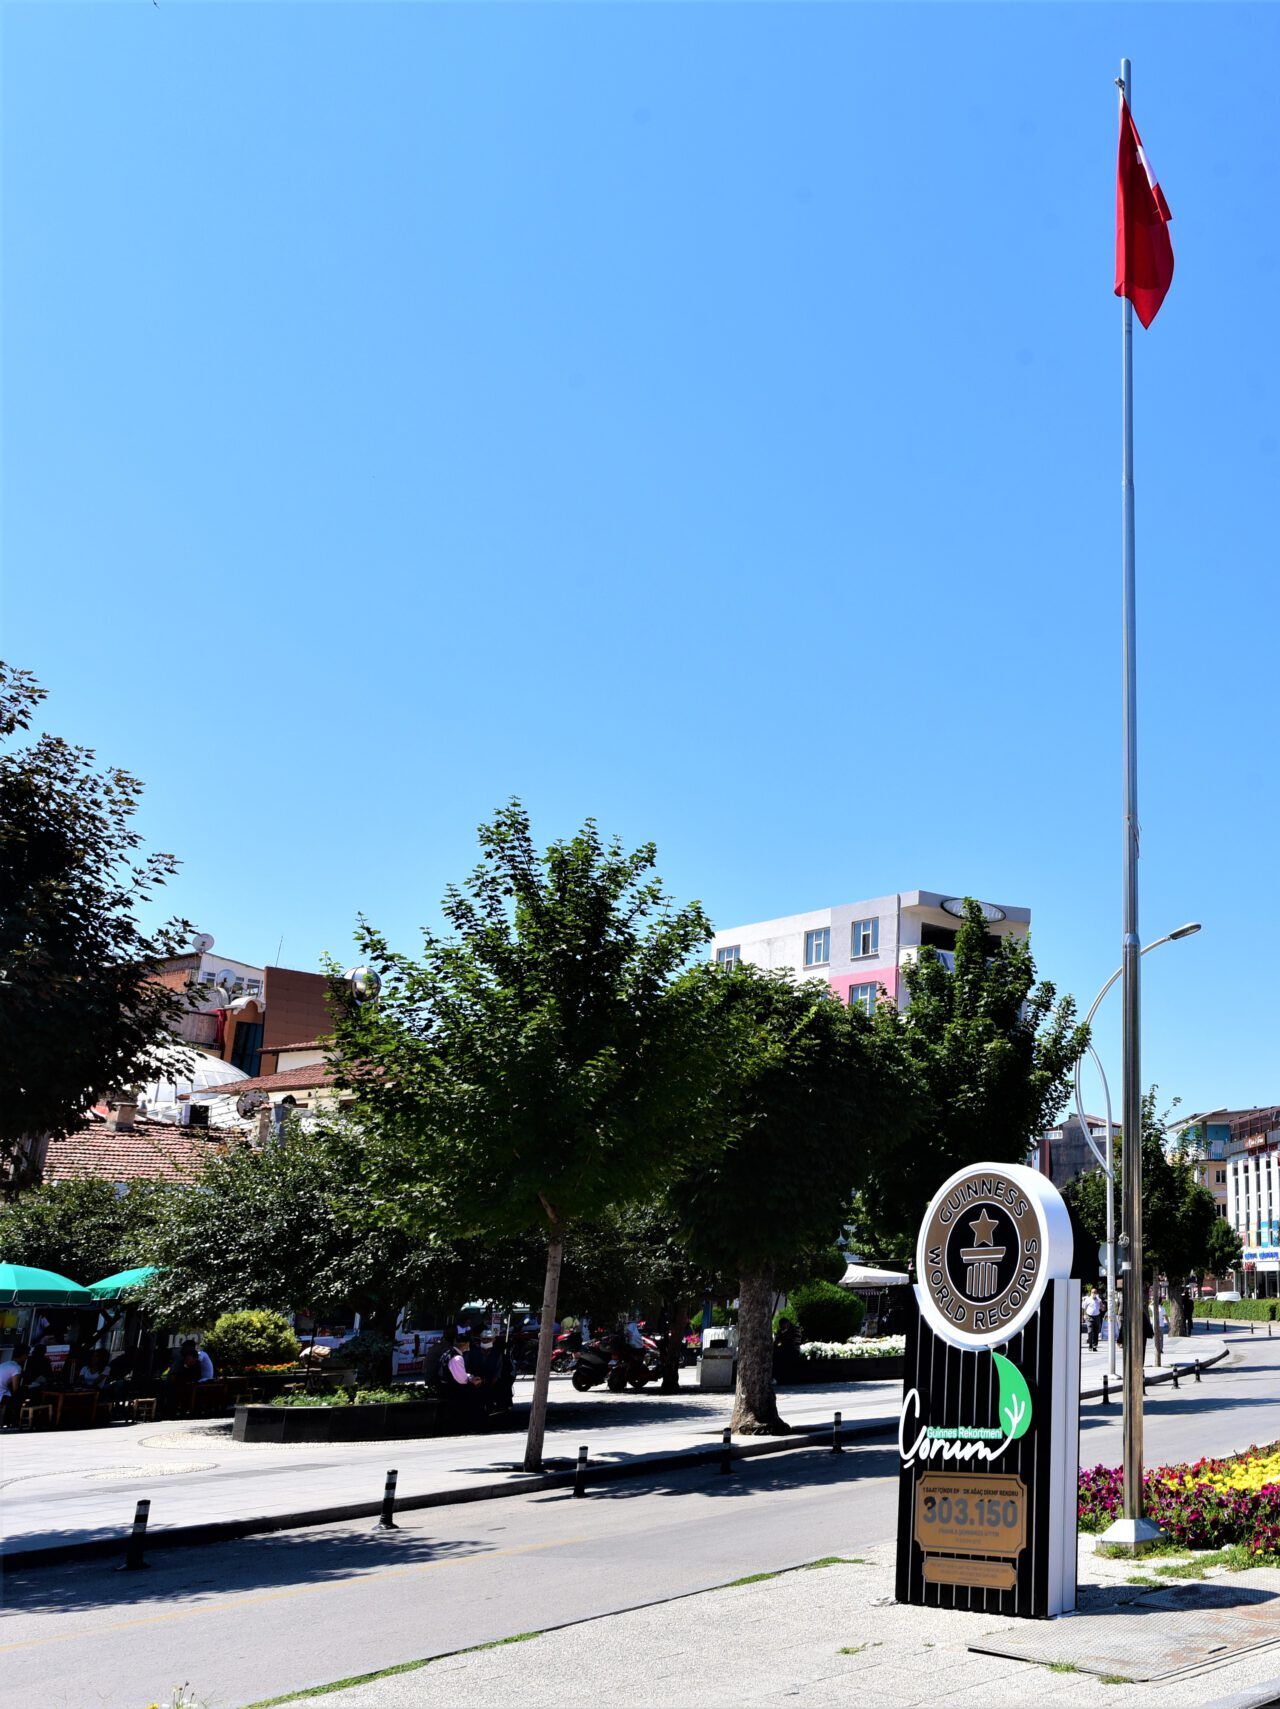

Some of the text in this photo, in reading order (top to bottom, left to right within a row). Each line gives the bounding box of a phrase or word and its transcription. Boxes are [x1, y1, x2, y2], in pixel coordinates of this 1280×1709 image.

[939, 1179, 1028, 1225] GUINNESS
[928, 1238, 1038, 1330] WORLD RECORDS
[923, 1496, 1018, 1528] 303.150
